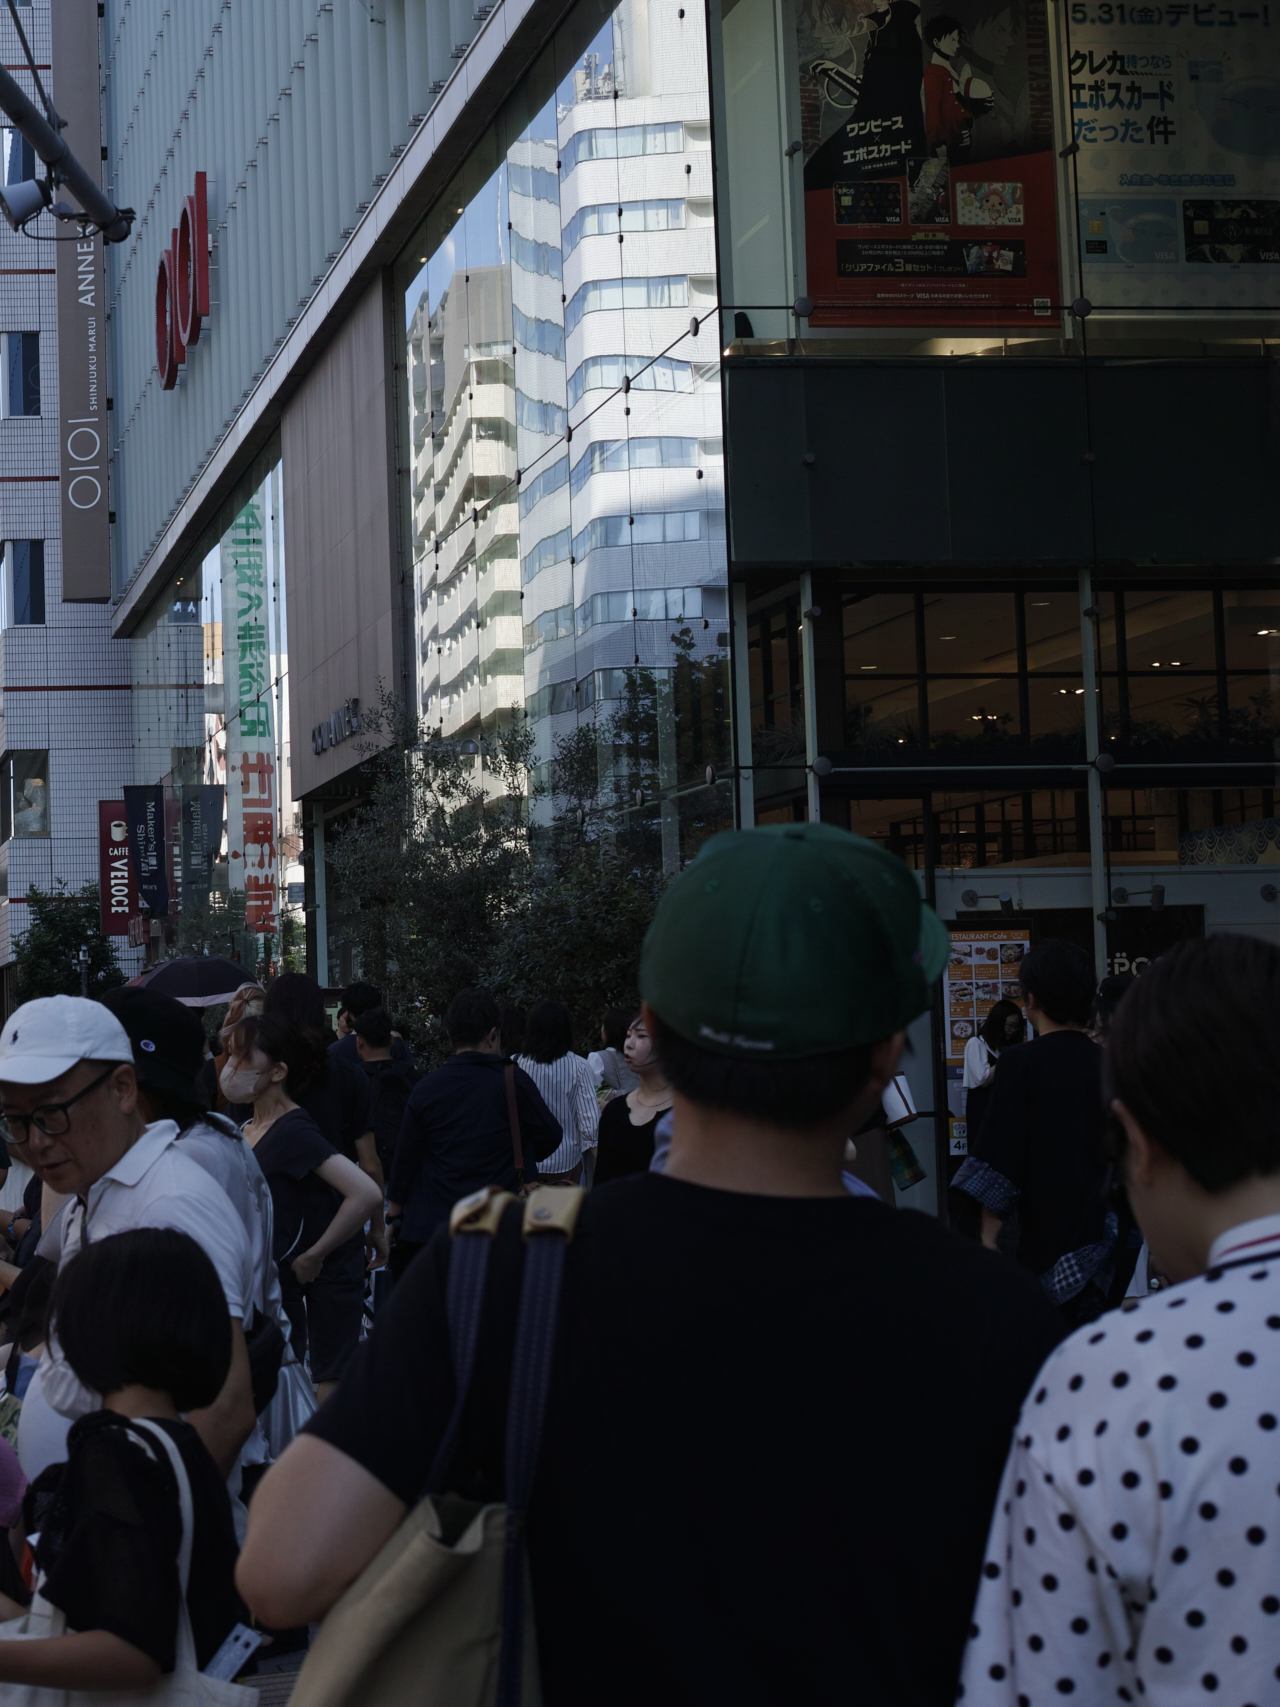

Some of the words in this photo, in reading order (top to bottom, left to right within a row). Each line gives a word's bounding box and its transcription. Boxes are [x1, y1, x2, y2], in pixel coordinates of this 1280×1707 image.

[1070, 79, 1175, 112] エポスカード
[799, 75, 822, 155] SHANKS
[846, 115, 904, 138] ワンピース
[1073, 115, 1176, 145] だった件
[842, 139, 912, 165] エポスカード
[77, 224, 96, 307] ANNEX
[1153, 251, 1176, 260] VISA
[1258, 251, 1280, 260] VISA
[88, 316, 96, 356] MARUI
[89, 358, 97, 411] SHINJUKU
[110, 858, 129, 914] VELOCE
[953, 1141, 968, 1151] 4F
